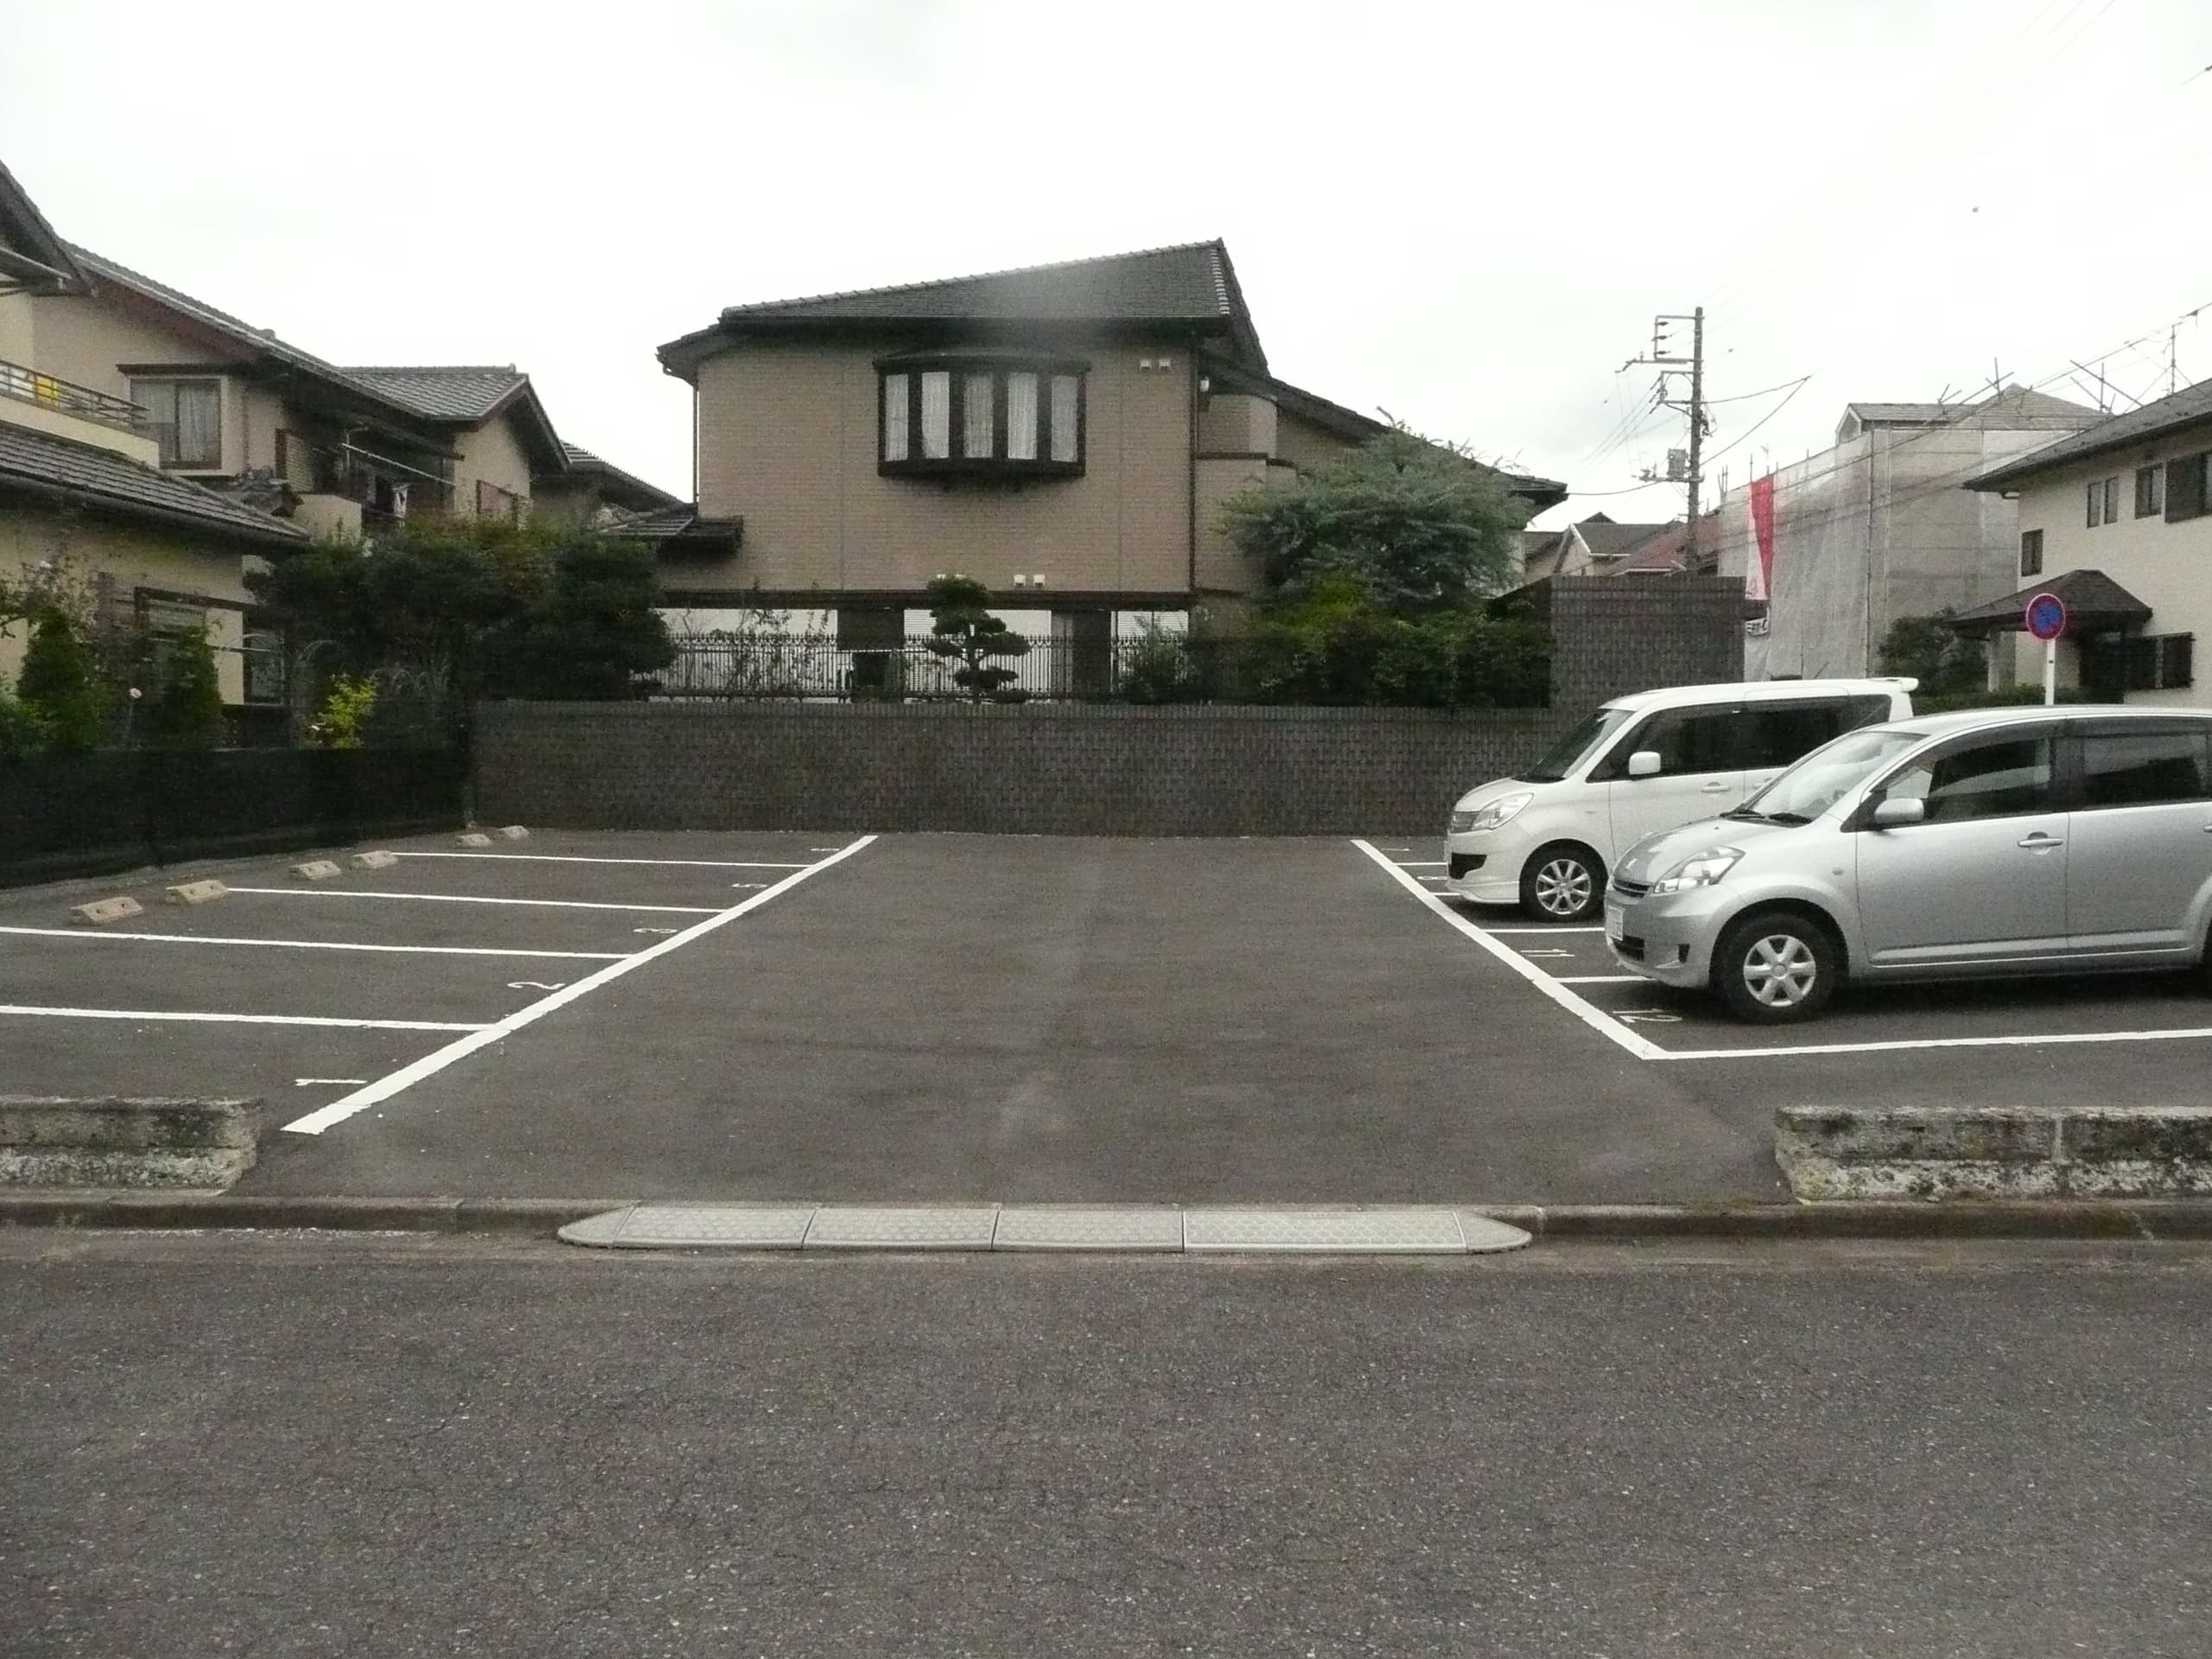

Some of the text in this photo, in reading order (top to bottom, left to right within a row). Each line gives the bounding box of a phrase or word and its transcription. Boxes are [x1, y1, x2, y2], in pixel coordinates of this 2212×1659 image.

[1520, 949, 1575, 957] 11
[506, 982, 566, 990] 2
[1612, 1008, 1683, 1023] 12
